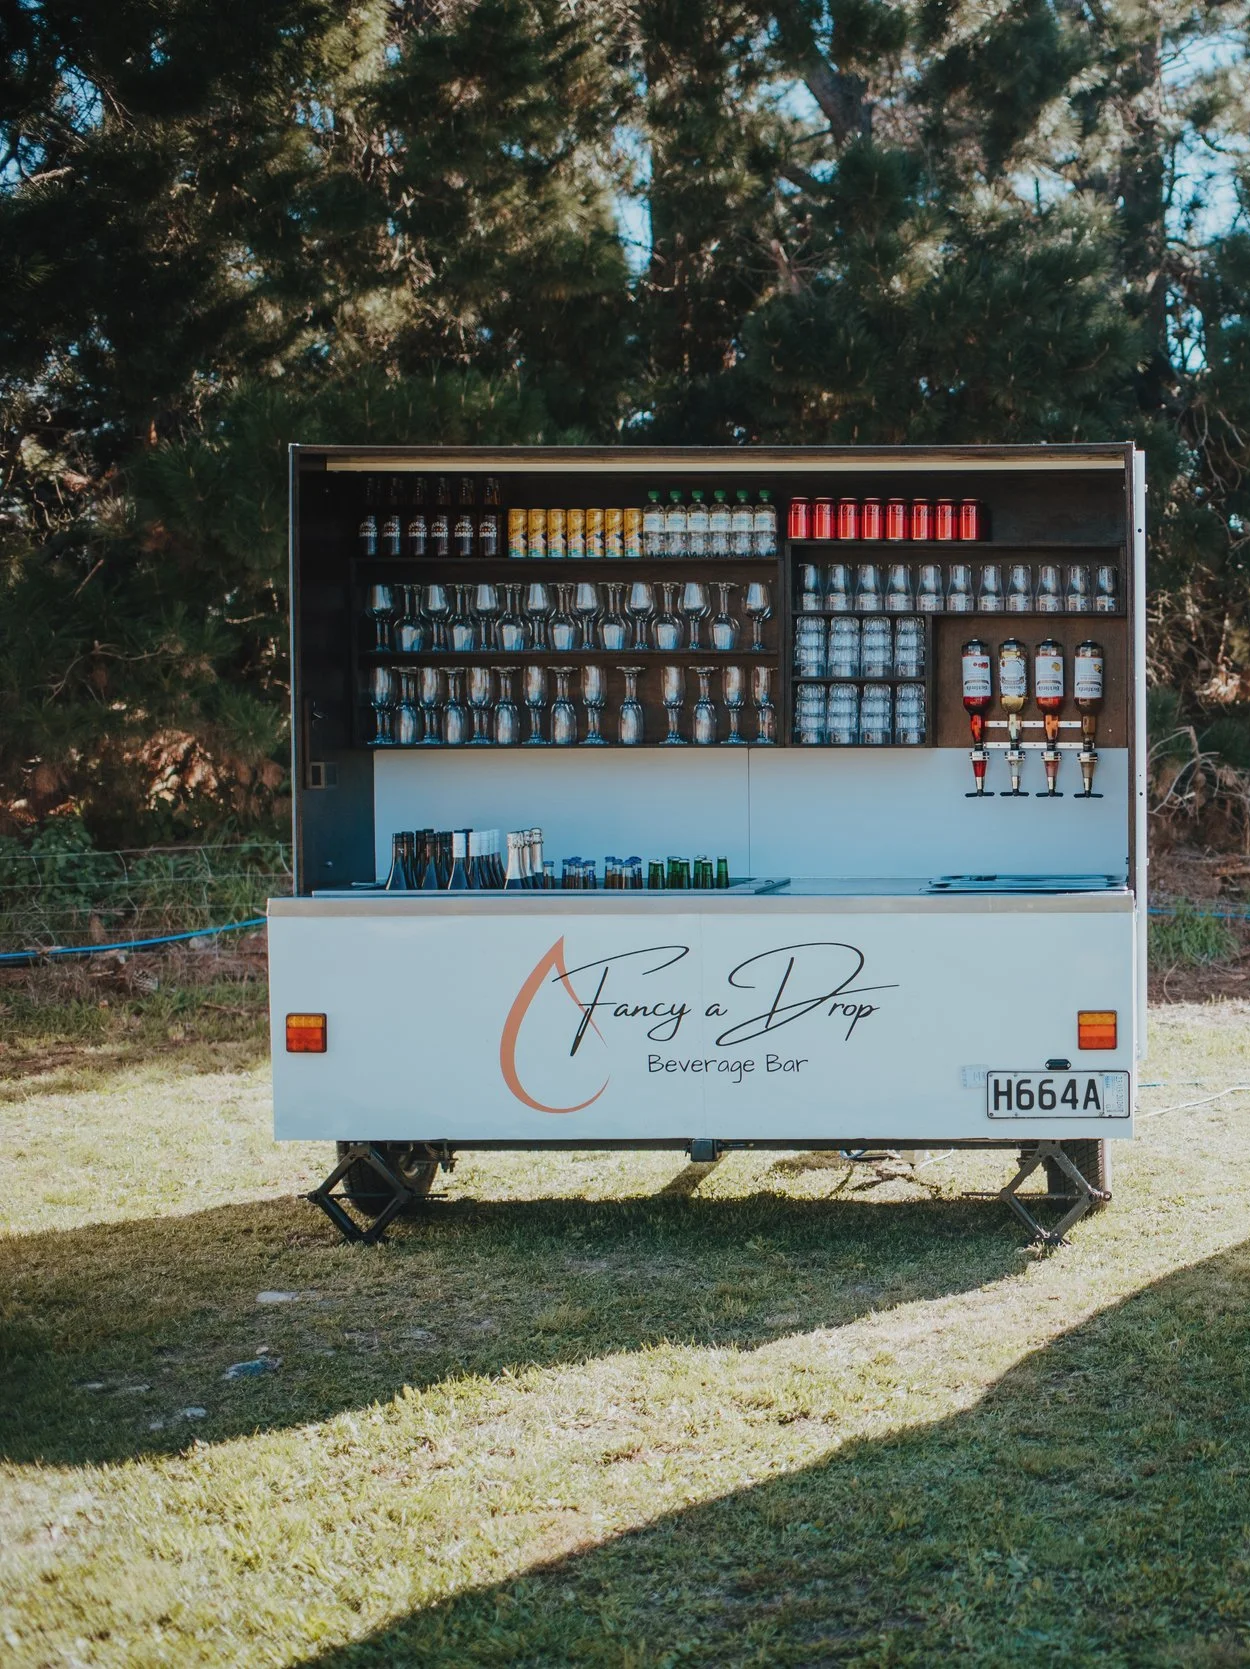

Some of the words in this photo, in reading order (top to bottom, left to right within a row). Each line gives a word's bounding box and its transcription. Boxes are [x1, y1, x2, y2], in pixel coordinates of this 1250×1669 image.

[552, 945, 691, 1057] Fancy
[704, 1002, 728, 1017] a
[715, 942, 900, 1046] Drop
[648, 1054, 756, 1084] Beverage
[765, 1053, 809, 1073] Bar
[993, 1079, 1101, 1111] H664A
